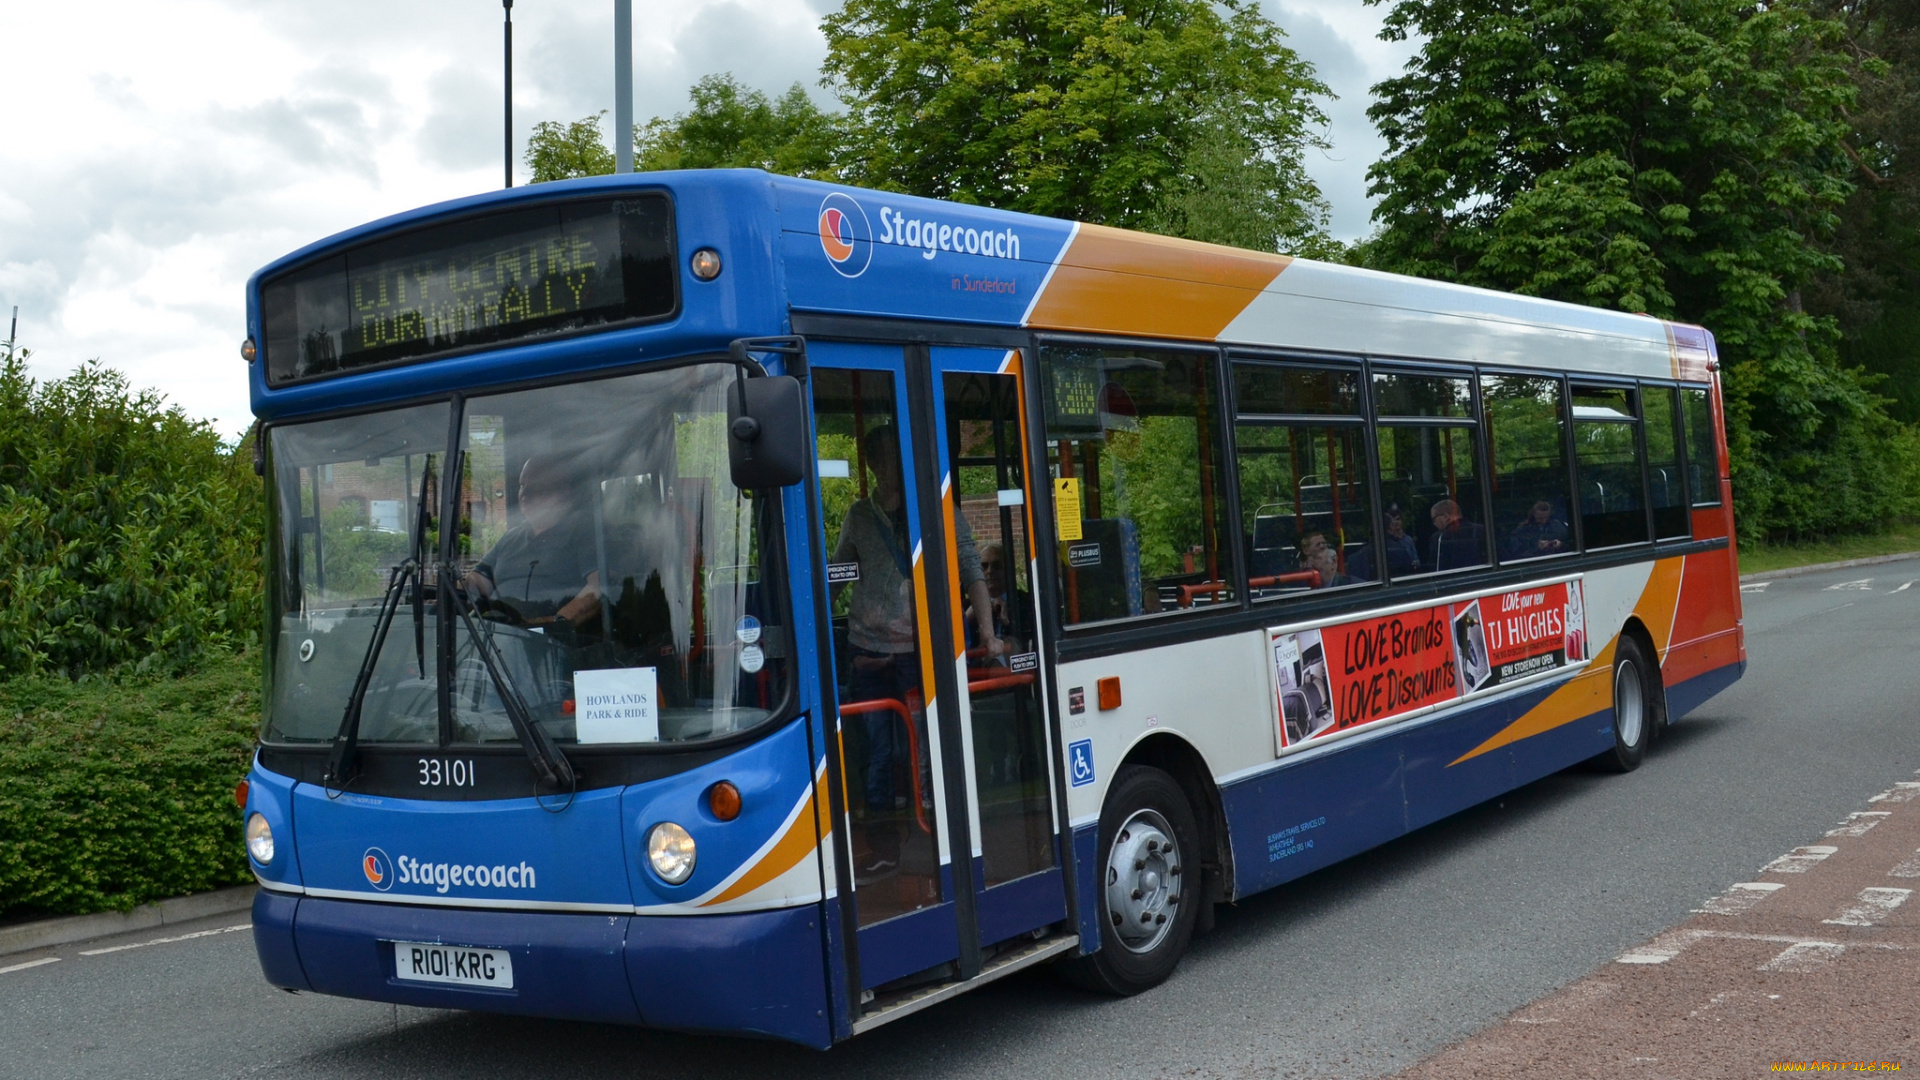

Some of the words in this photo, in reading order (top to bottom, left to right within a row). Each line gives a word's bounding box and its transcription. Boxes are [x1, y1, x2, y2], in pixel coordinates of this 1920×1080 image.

[880, 206, 1020, 260] Stagecoach
[951, 274, 961, 290] in
[964, 273, 1016, 294] Sunderland
[1502, 592, 1520, 612] LOVE
[1520, 594, 1533, 614] your
[1534, 592, 1545, 606] new
[1345, 622, 1388, 675] LOVE
[1390, 607, 1443, 660] Brands
[1488, 620, 1502, 650] TJ
[1507, 608, 1562, 646] HUGHES
[1501, 664, 1514, 677] NEW
[1514, 660, 1529, 674] STORE
[1541, 653, 1554, 666] OPEN
[586, 694, 647, 706] HOWLANDS
[1340, 672, 1384, 728] LOVE
[1387, 651, 1456, 711] Discounts
[586, 710, 612, 719] PARK
[614, 709, 622, 718] &
[624, 708, 647, 718] RIDE
[419, 758, 474, 786] 33101
[398, 855, 536, 893] Stagecoach
[412, 948, 449, 976] R101
[455, 951, 496, 980] KRG
